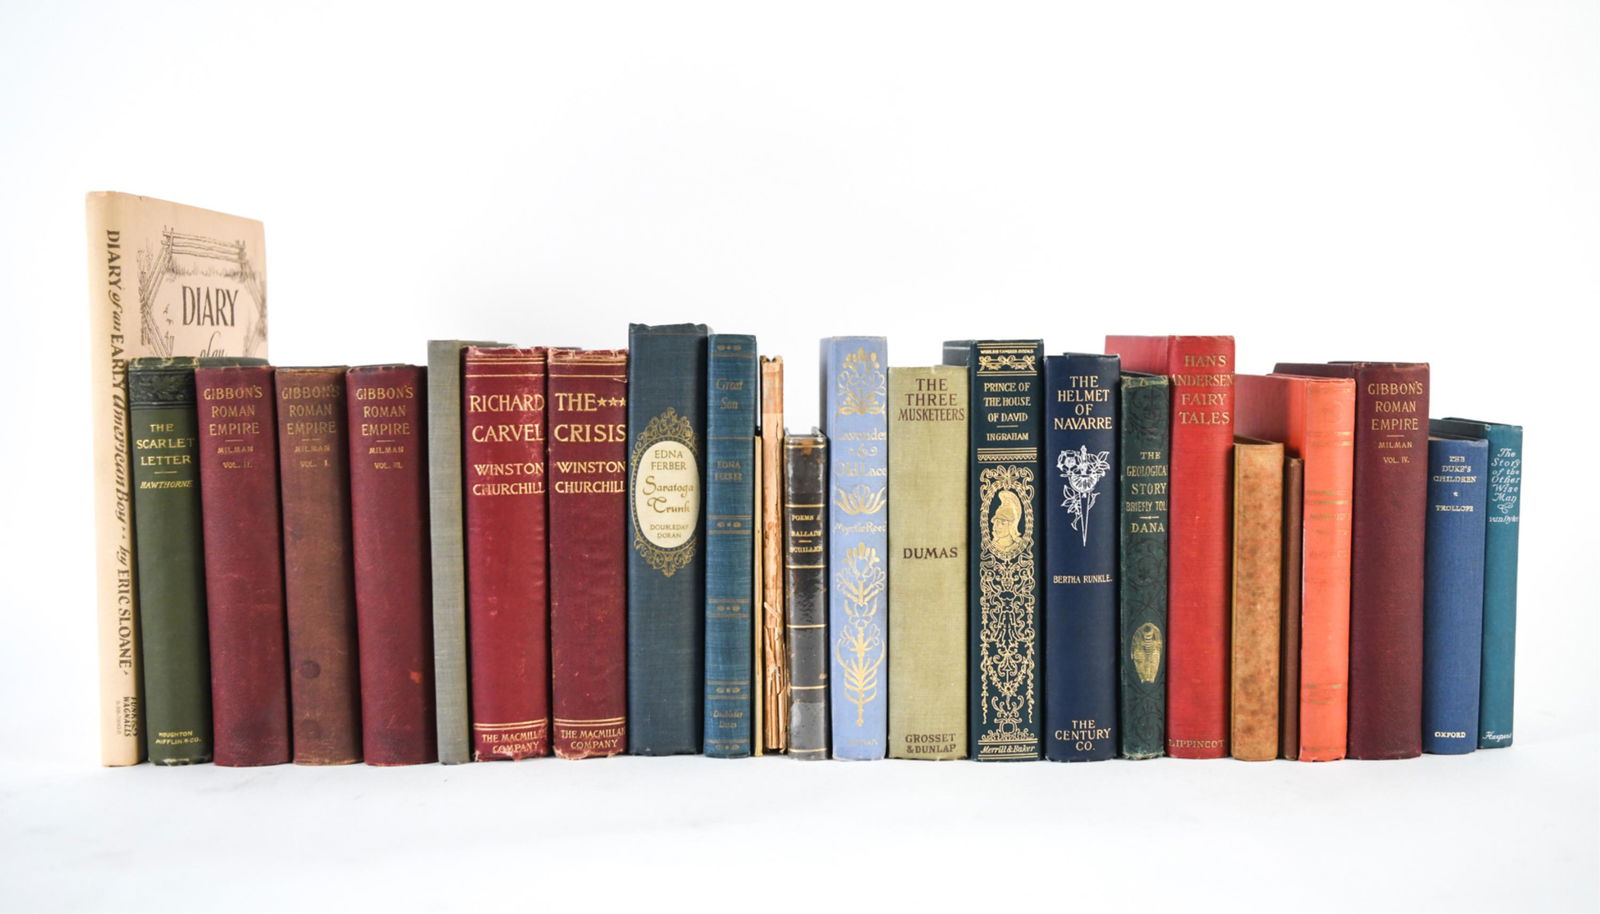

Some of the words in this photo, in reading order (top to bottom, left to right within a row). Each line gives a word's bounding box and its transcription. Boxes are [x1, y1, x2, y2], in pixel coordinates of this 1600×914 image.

[106, 230, 121, 290] DIARY
[108, 287, 123, 313] of
[182, 286, 239, 327] DIARY
[110, 334, 127, 390] EARLY
[1185, 354, 1227, 368] HANS
[715, 378, 744, 391] Great
[915, 378, 948, 391] THE
[984, 382, 1017, 392] PRINCE
[1018, 382, 1031, 391] OF
[1070, 376, 1099, 388] THE
[1368, 381, 1424, 395] GIBBON'S
[204, 385, 263, 400] GIBBON'S
[282, 384, 340, 400] GIBBON'S
[356, 385, 413, 400] GIBBON'S
[1058, 389, 1110, 402] HELMET
[469, 394, 545, 412] RICHARD
[555, 393, 598, 412] THE
[720, 397, 739, 409] Son
[905, 393, 958, 406] THREE
[984, 397, 1002, 407] THE
[1003, 397, 1031, 406] HOUSE
[1182, 393, 1227, 406] FAIRY
[212, 405, 255, 418] ROMAN
[289, 404, 332, 417] ROMAN
[363, 405, 406, 418] ROMAN
[1074, 404, 1093, 415] OF
[1375, 401, 1416, 413] ROMAN
[898, 408, 965, 421] MUSKETEERS
[987, 413, 999, 422] OF
[1001, 412, 1028, 422] DAVID
[1179, 412, 1231, 425] TALES
[150, 423, 174, 432] THE
[209, 422, 260, 436] EMPIRE
[287, 421, 336, 435] EMPIRE
[362, 422, 410, 436] EMPIRE
[1054, 417, 1112, 430] NAVARRE
[1371, 418, 1419, 431] EMPIRE
[472, 424, 545, 443] CARVEL
[554, 424, 626, 443] CRISIS
[987, 432, 1029, 440] INGRAHAM
[113, 394, 128, 488] American
[136, 438, 195, 450] SCARLET
[369, 446, 404, 454] MILMAN
[654, 449, 683, 459] EDNA
[1497, 447, 1516, 458] The
[140, 455, 192, 466] LETTER
[651, 461, 686, 471] FERBER
[1491, 457, 1520, 468] Story
[474, 462, 544, 476] WINSTON
[556, 461, 626, 474] WINSTON
[1492, 467, 1503, 477] of
[1506, 467, 1520, 476] the
[140, 480, 193, 489] HAWTHORNE
[1433, 475, 1477, 483] CHILDREN
[1491, 475, 1520, 484] Other
[473, 481, 545, 496] CHURCHILL
[555, 481, 626, 494] CHURCHILL
[642, 475, 694, 498] Saratoga
[1131, 482, 1167, 495] STORY
[1492, 483, 1518, 492] Wise
[1491, 492, 1517, 503] Man
[115, 487, 128, 524] Boy
[647, 497, 690, 514] Trunk
[1131, 523, 1165, 533] DANA
[903, 547, 958, 559] DUMAS
[1053, 575, 1081, 584] BERTHA
[118, 569, 131, 606] ERIC
[118, 608, 132, 668] SLOANE
[1072, 720, 1096, 729] THE
[481, 733, 499, 743] THE
[560, 730, 577, 738] THE
[905, 733, 956, 743] GROSSET
[1054, 728, 1111, 740] CENTURY
[492, 741, 539, 754] COMPANY
[570, 739, 618, 750] COMPANY
[1075, 741, 1096, 751] CO.
